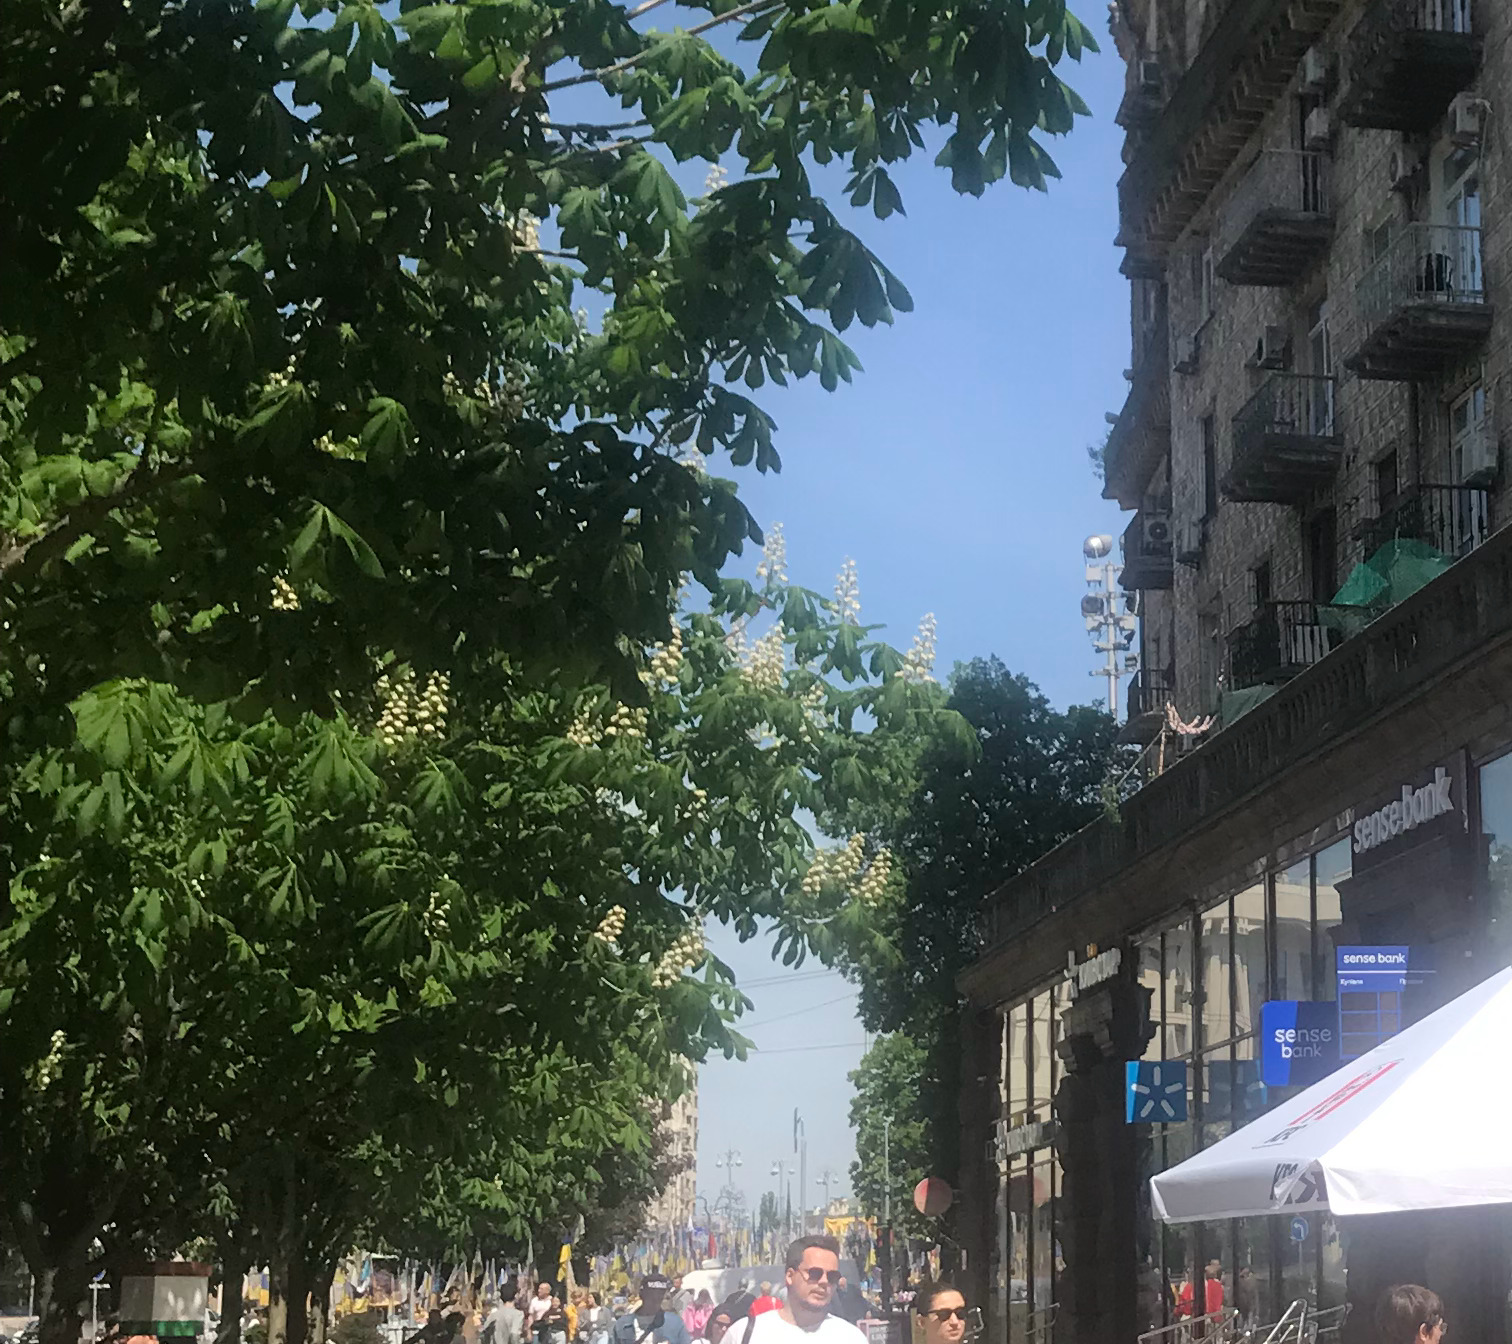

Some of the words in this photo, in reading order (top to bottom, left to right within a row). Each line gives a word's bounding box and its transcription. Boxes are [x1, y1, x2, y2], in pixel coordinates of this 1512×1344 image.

[1353, 800, 1404, 854] sense
[1401, 765, 1454, 830] bank
[1343, 953, 1376, 964] sense
[1377, 952, 1406, 964] bank
[1274, 1028, 1332, 1043] sense
[1281, 1044, 1322, 1058] bank
